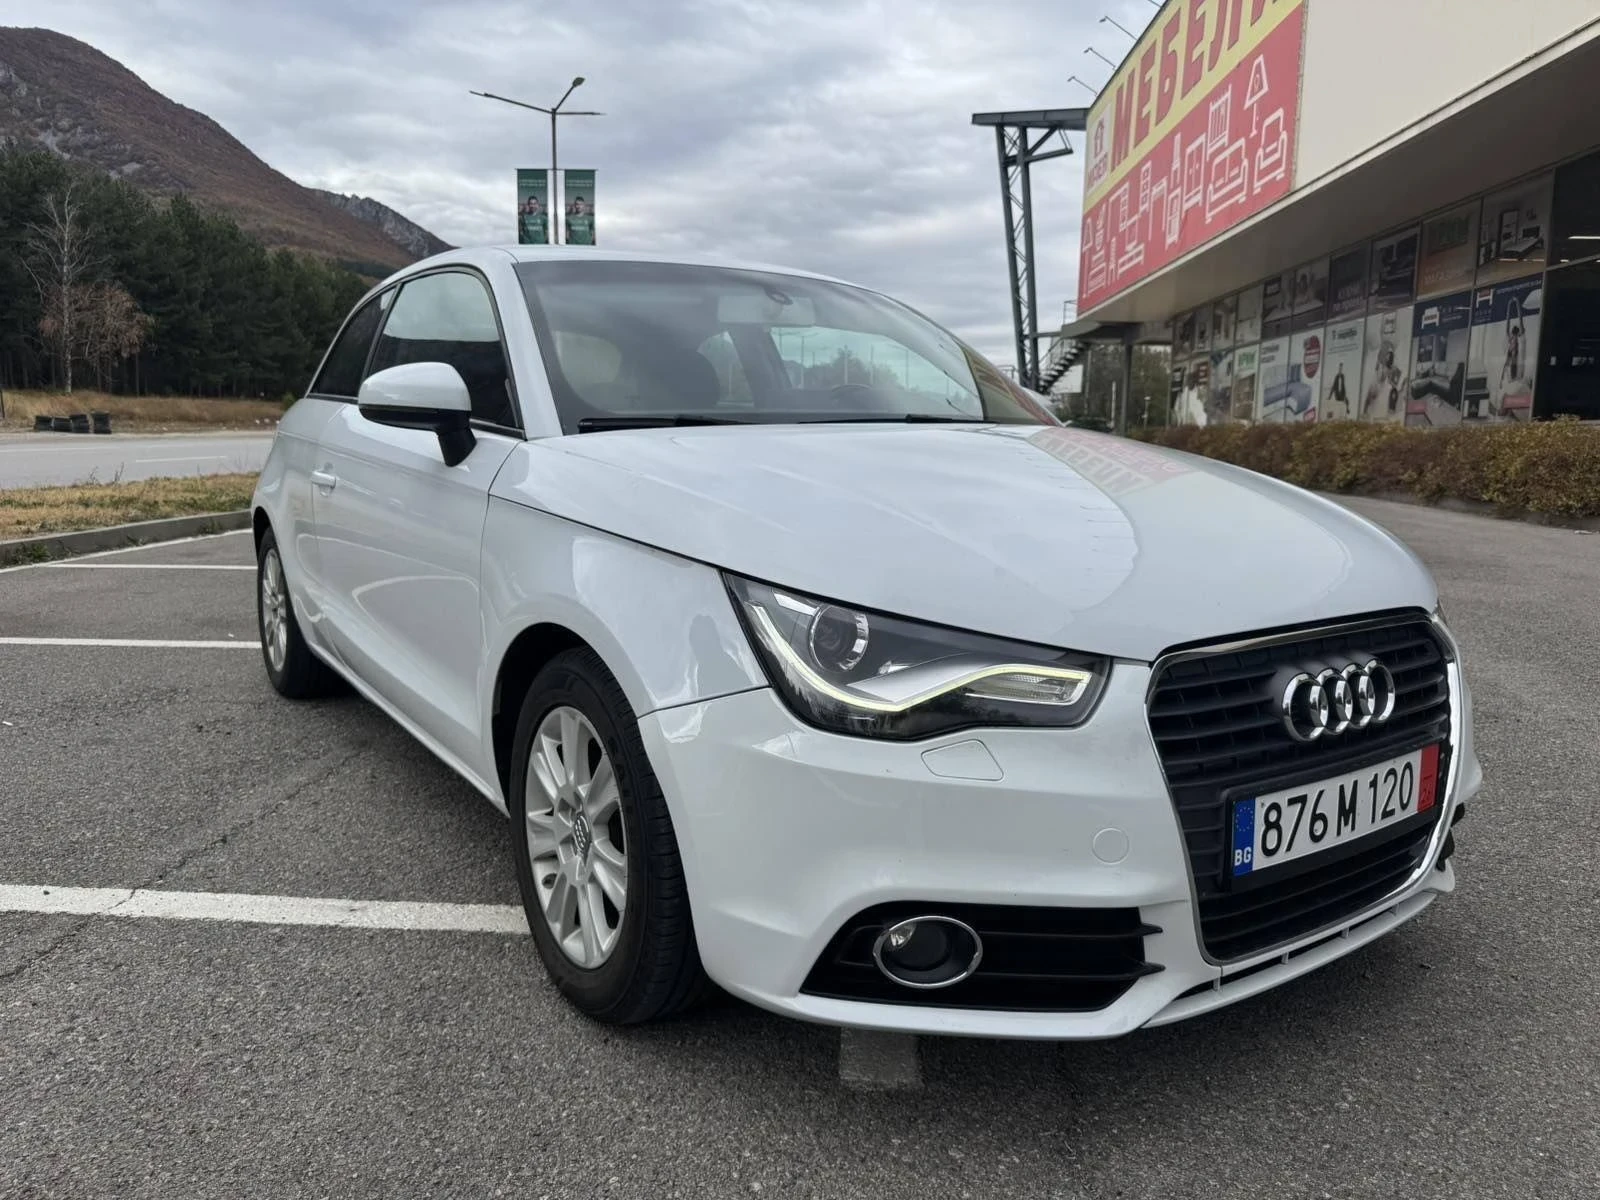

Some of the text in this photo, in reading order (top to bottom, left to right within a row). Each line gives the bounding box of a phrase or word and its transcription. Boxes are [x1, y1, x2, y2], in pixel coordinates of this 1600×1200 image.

[1110, 0, 1280, 172] МЕБЕЛ
[1234, 846, 1252, 866] BG
[1261, 761, 1414, 857] 876 M 120
